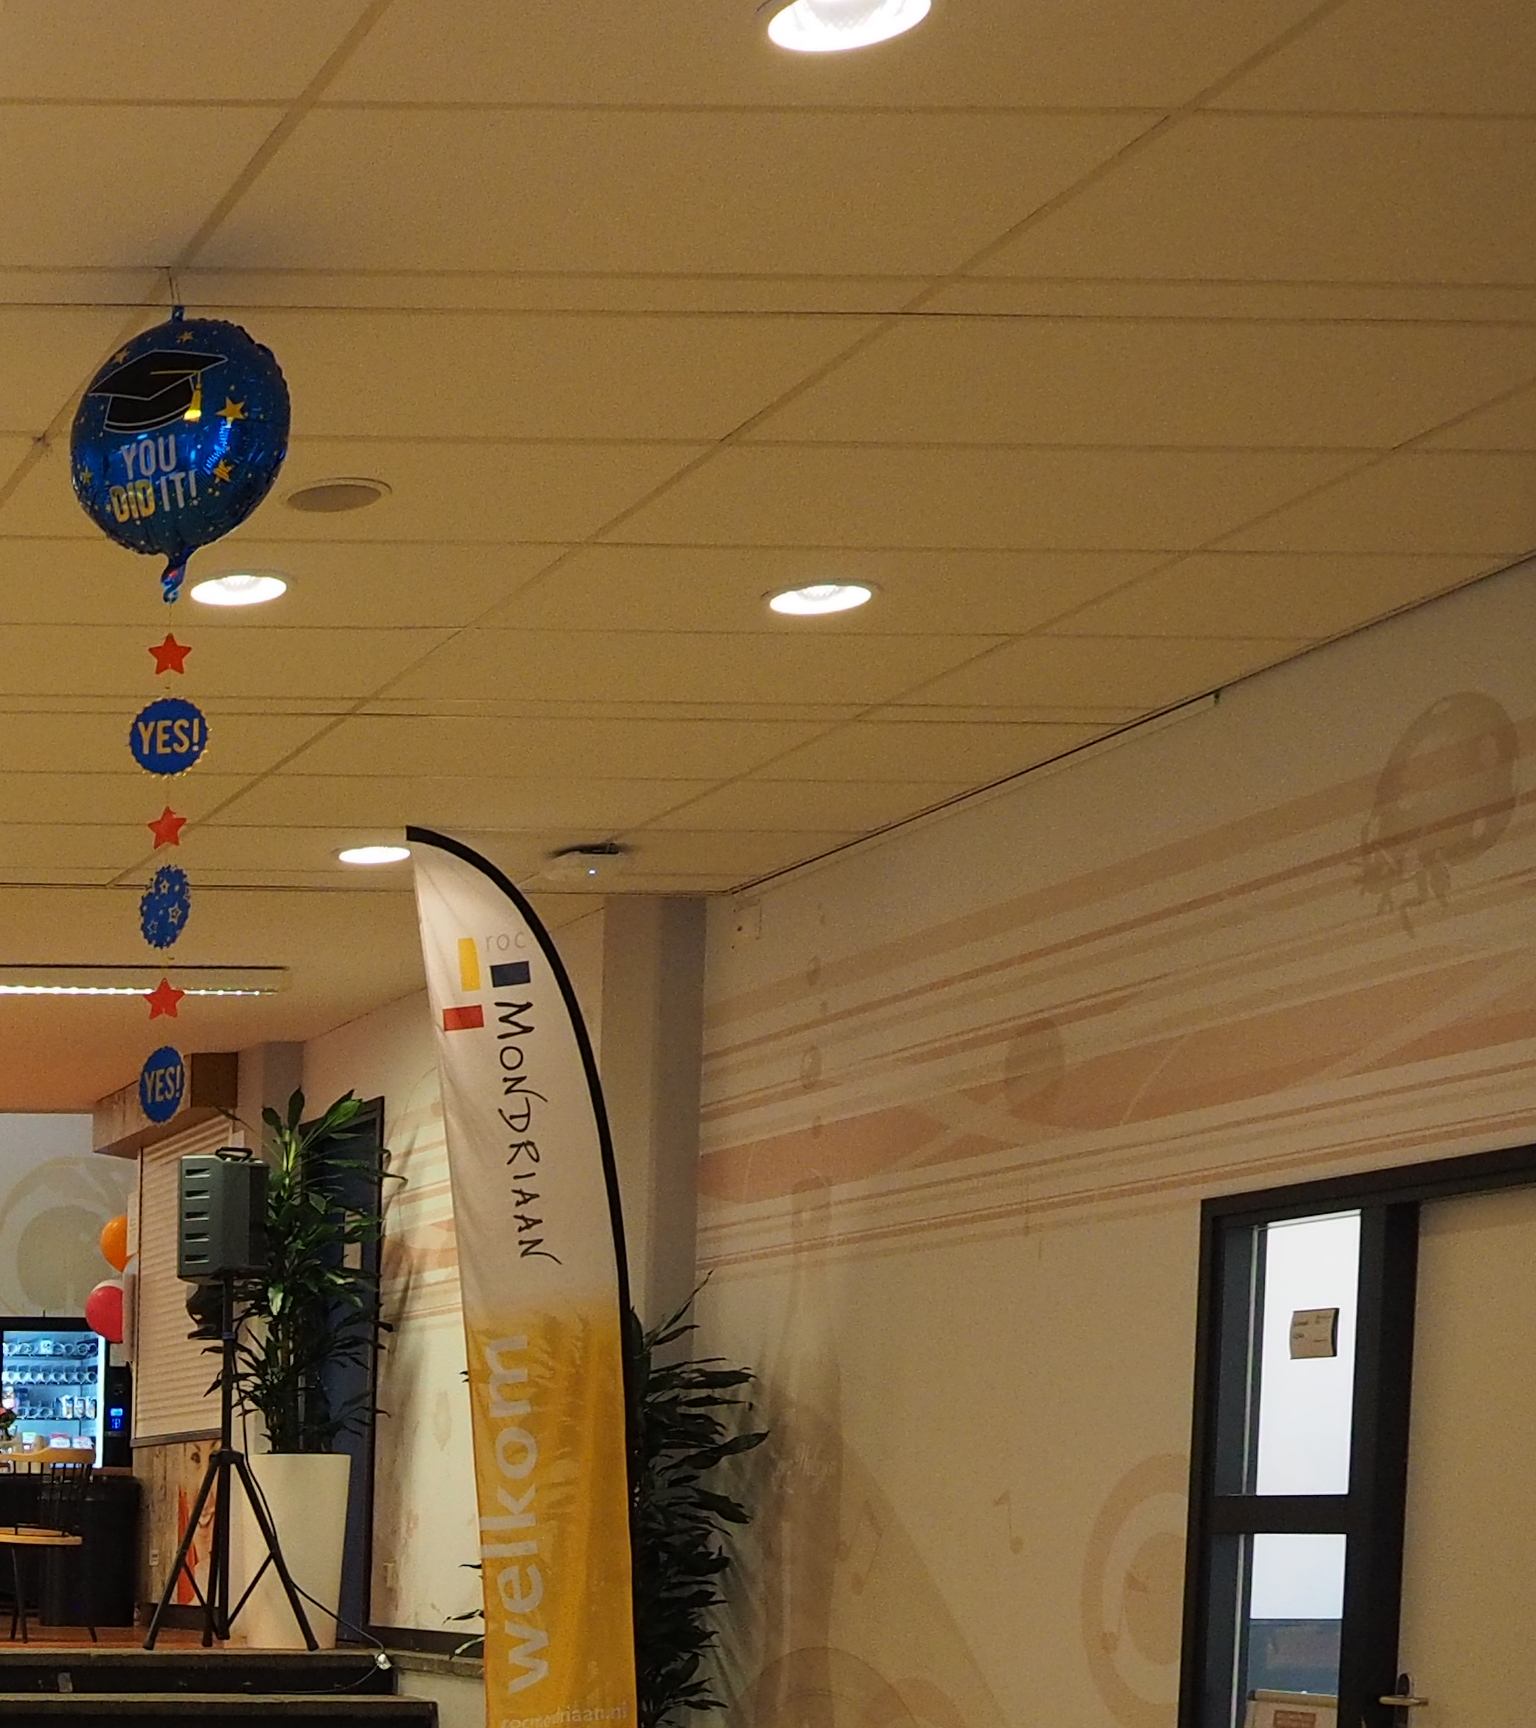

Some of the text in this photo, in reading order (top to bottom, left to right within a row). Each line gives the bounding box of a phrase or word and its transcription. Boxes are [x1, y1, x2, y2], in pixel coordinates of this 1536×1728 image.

[120, 434, 177, 480] YOU
[109, 469, 198, 523] DID IT!
[137, 718, 200, 755] YES!
[486, 931, 527, 951] roc
[144, 1065, 182, 1104] YES!
[494, 1002, 562, 1265] MONDRIAAN
[479, 1335, 549, 1694] welkom
